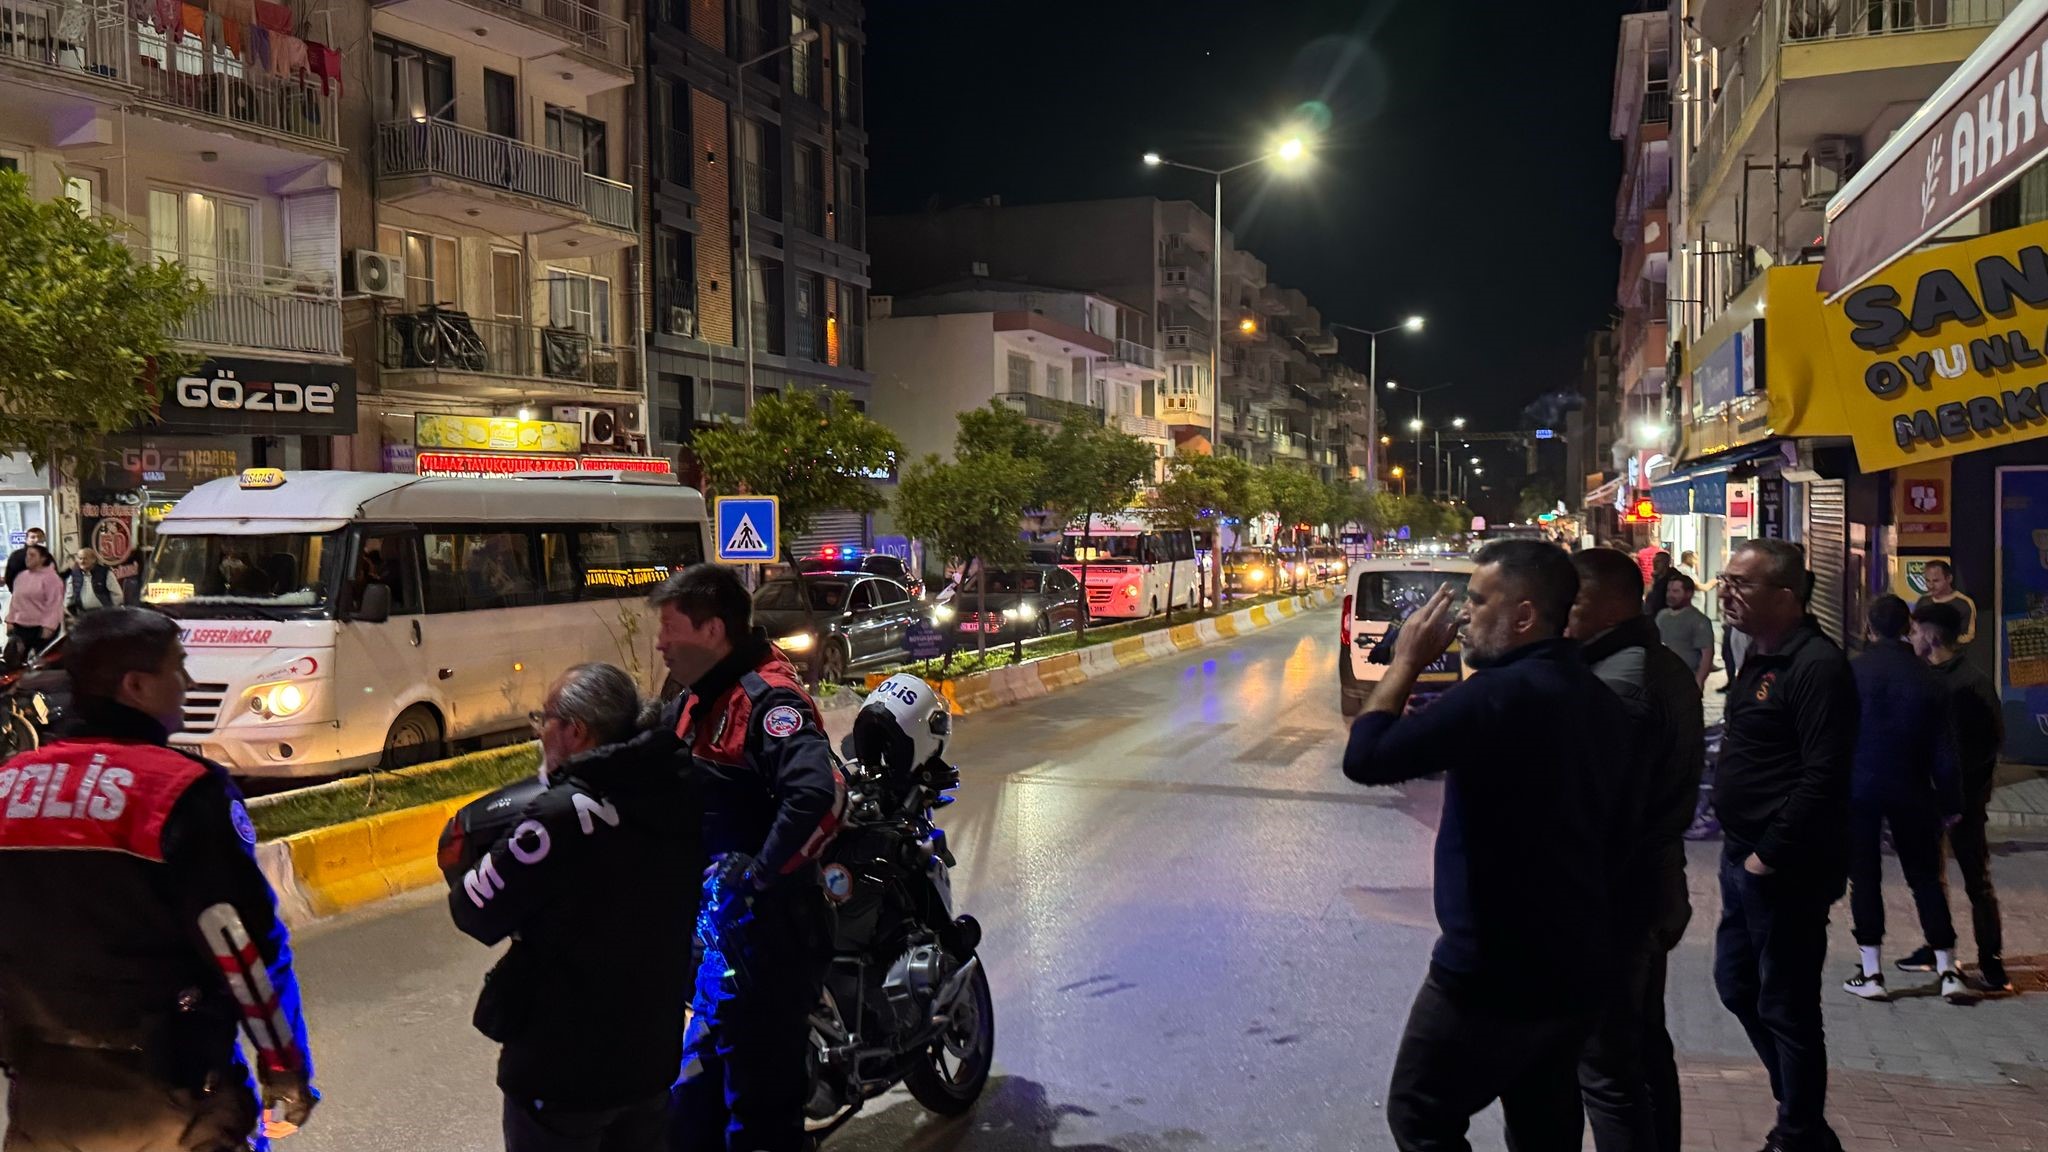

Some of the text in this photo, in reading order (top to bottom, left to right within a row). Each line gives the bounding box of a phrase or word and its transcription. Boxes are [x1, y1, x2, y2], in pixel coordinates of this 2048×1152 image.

[1950, 39, 2048, 196] AKK
[1844, 245, 2048, 348] SAN
[1865, 328, 2048, 395] OYUNL
[422, 456, 464, 470] YILMAZ
[878, 681, 918, 706] OLİS
